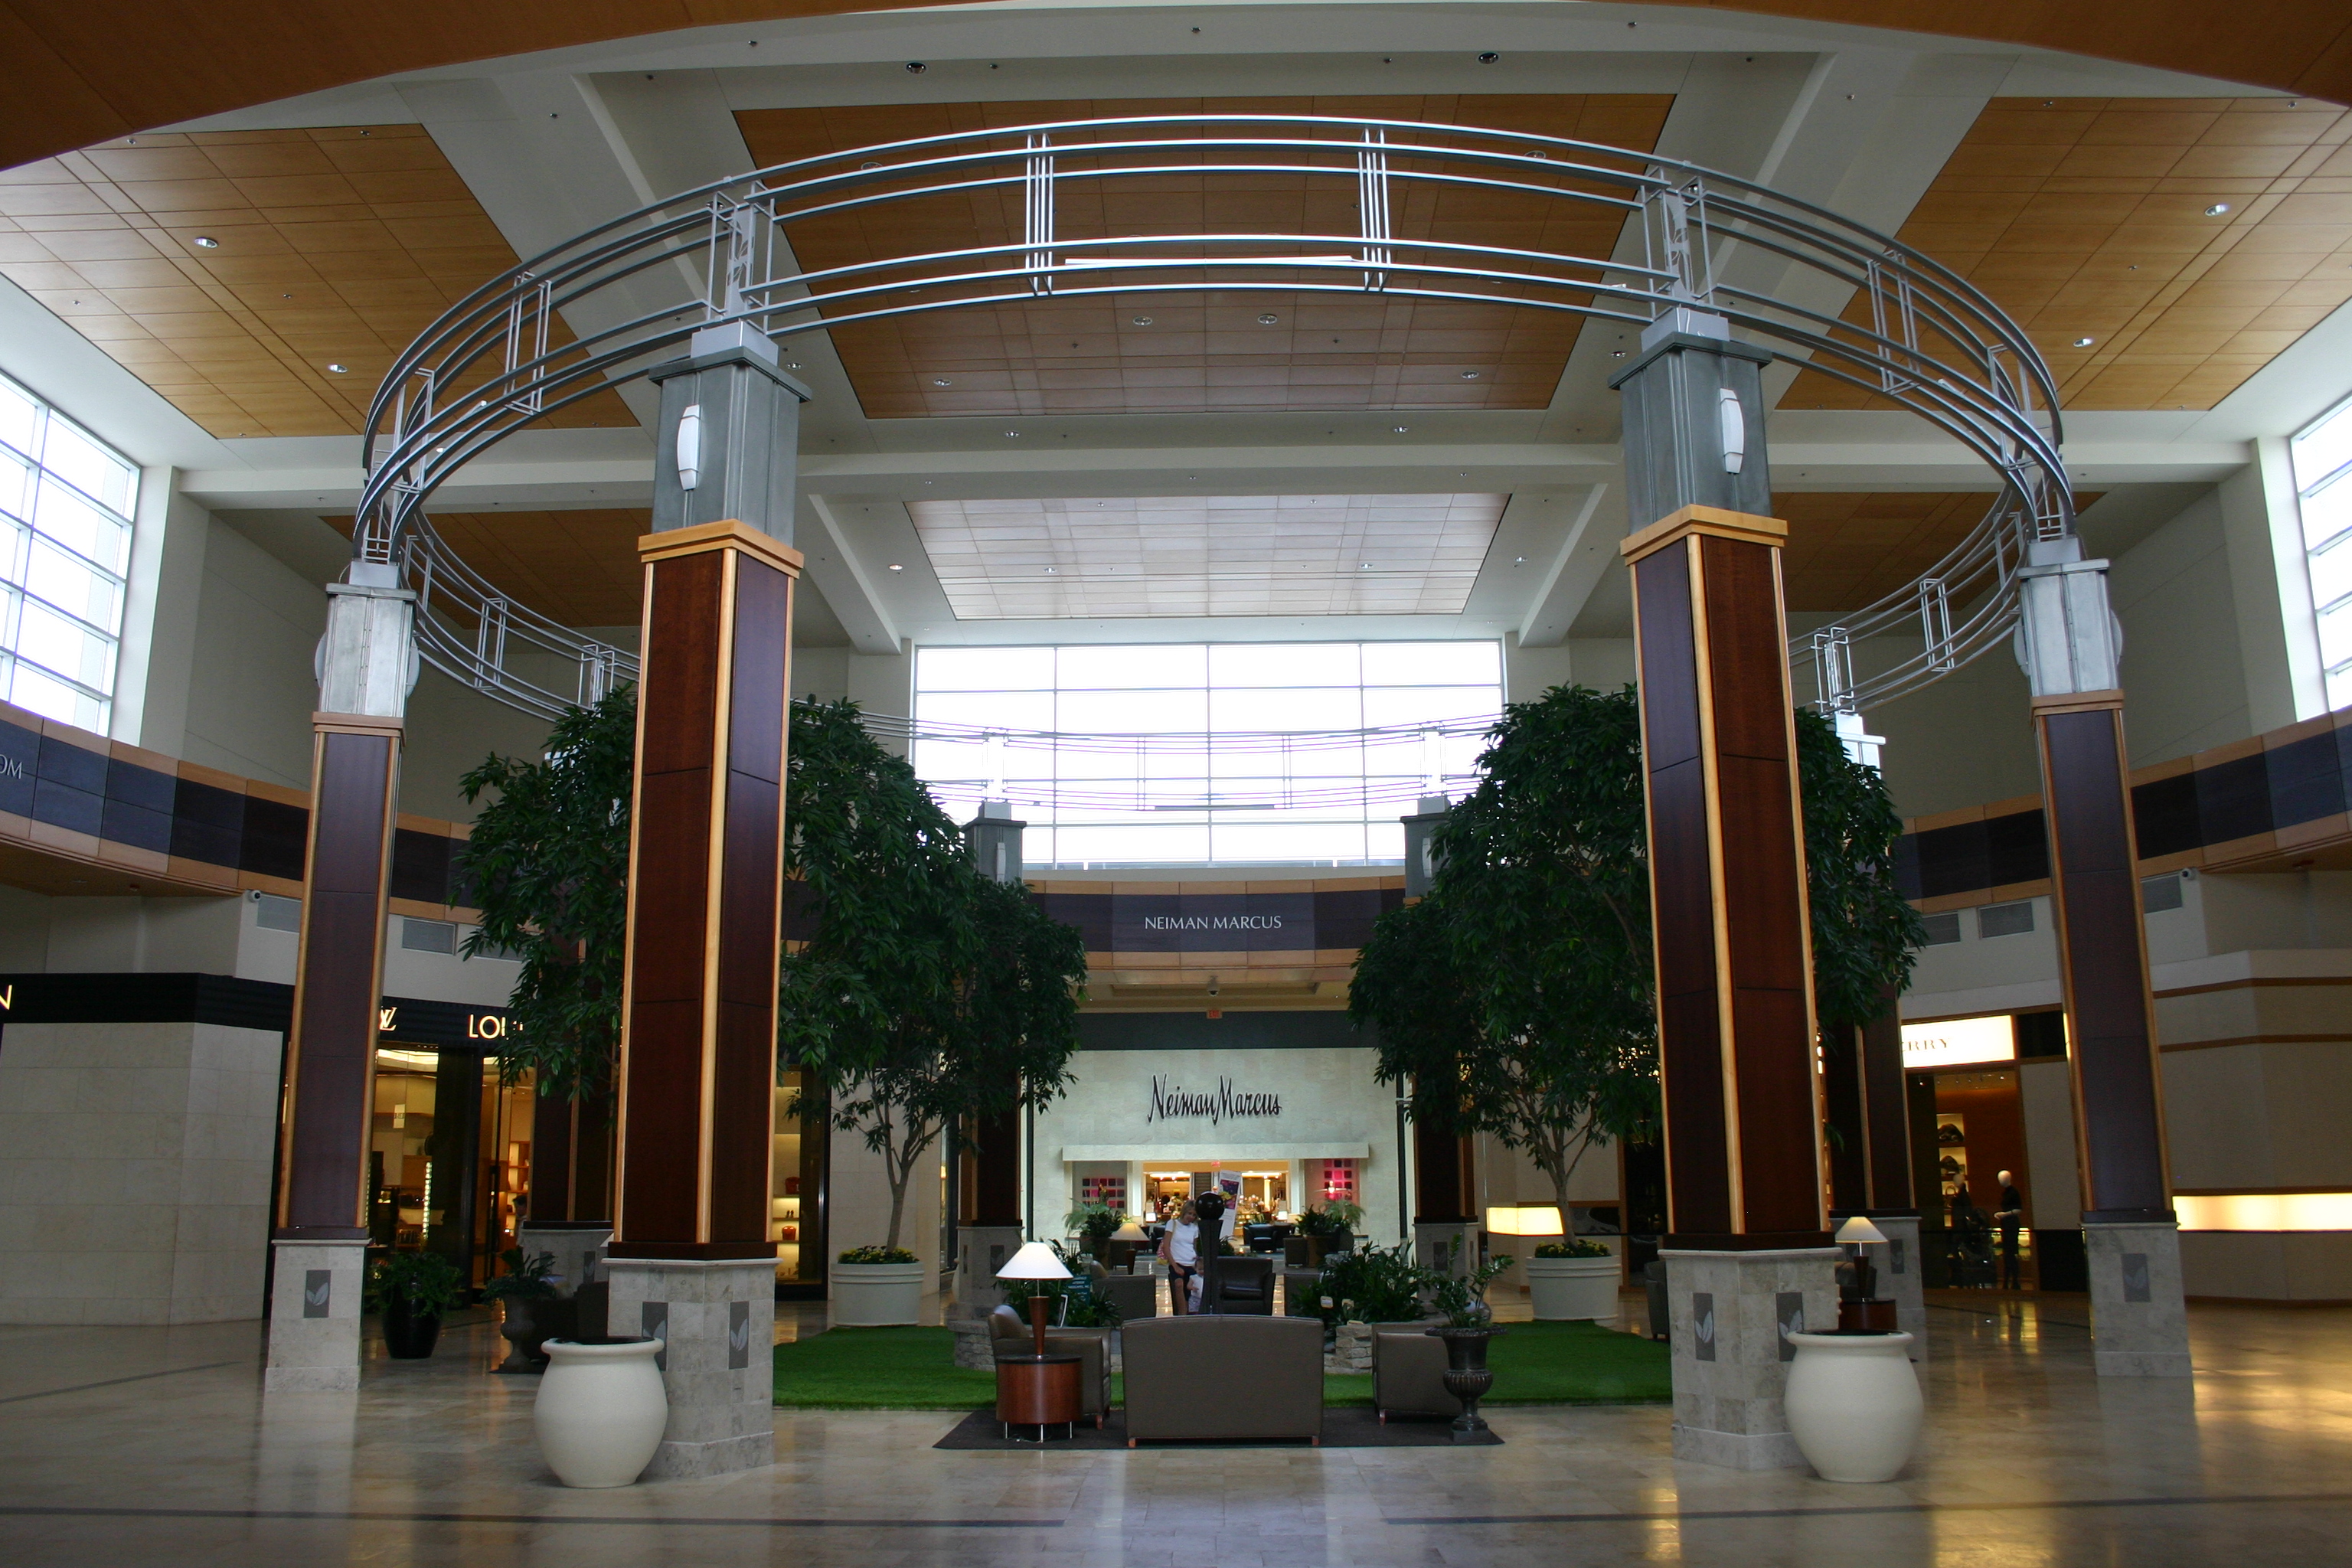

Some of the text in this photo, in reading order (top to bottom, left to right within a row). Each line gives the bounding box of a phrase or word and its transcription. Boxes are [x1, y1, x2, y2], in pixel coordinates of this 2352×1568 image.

[1145, 916, 1282, 929] NEIMAN MARCUS
[1148, 1073, 1282, 1126] Neiman Marcus
